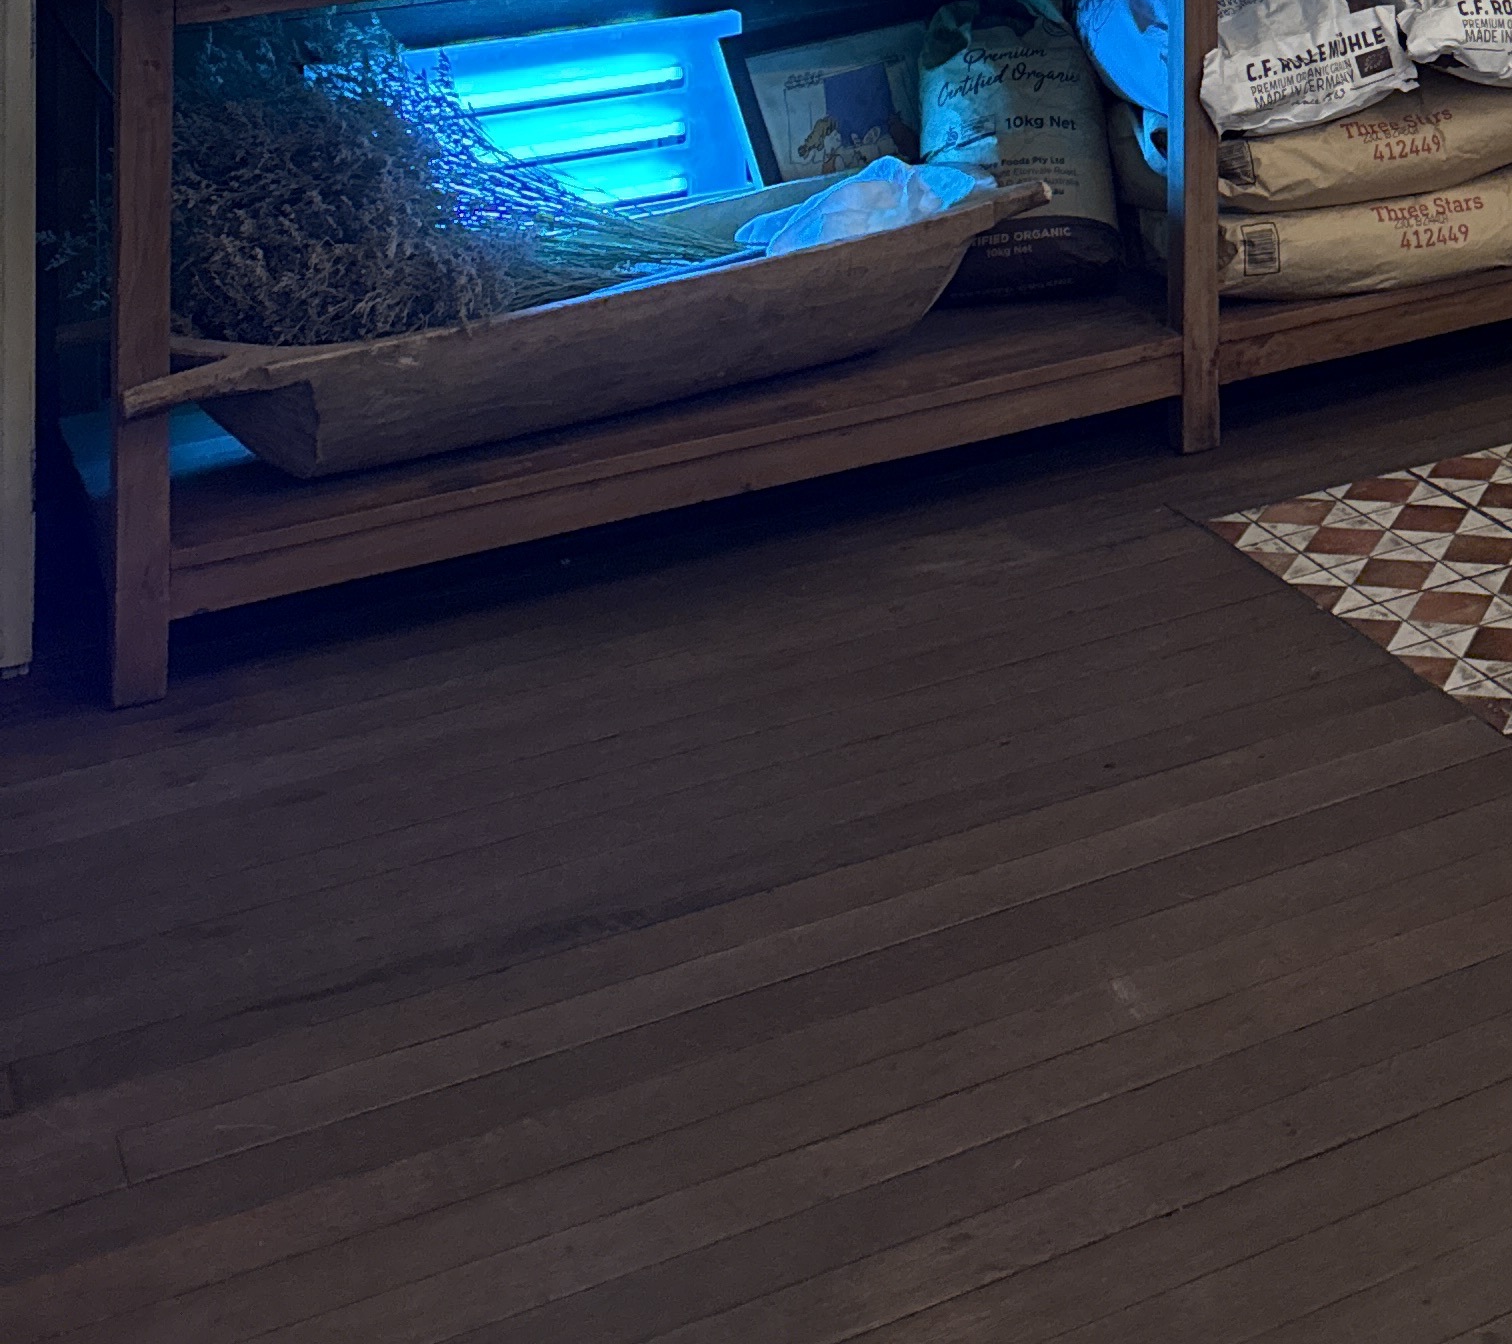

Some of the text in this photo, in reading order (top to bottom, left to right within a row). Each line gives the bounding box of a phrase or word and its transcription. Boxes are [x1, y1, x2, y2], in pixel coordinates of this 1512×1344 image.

[1458, 0, 1488, 15] C.F.
[1462, 18, 1505, 29] PREMIUM
[1465, 29, 1498, 43] MADE
[1501, 30, 1512, 43] IN
[963, 47, 1047, 72] Premium
[938, 63, 1080, 107] Certified Organic
[1251, 76, 1294, 95] PREMIUM
[1254, 88, 1287, 109] MADE
[1006, 116, 1076, 130] 10kg Net
[1340, 120, 1400, 139] Three
[1403, 109, 1453, 129] Stars
[1373, 134, 1441, 161] 412449
[1371, 206, 1428, 223] Three
[1434, 195, 1484, 216] Stars
[1014, 227, 1071, 241] ORGANIC
[1401, 224, 1469, 249] 412449
